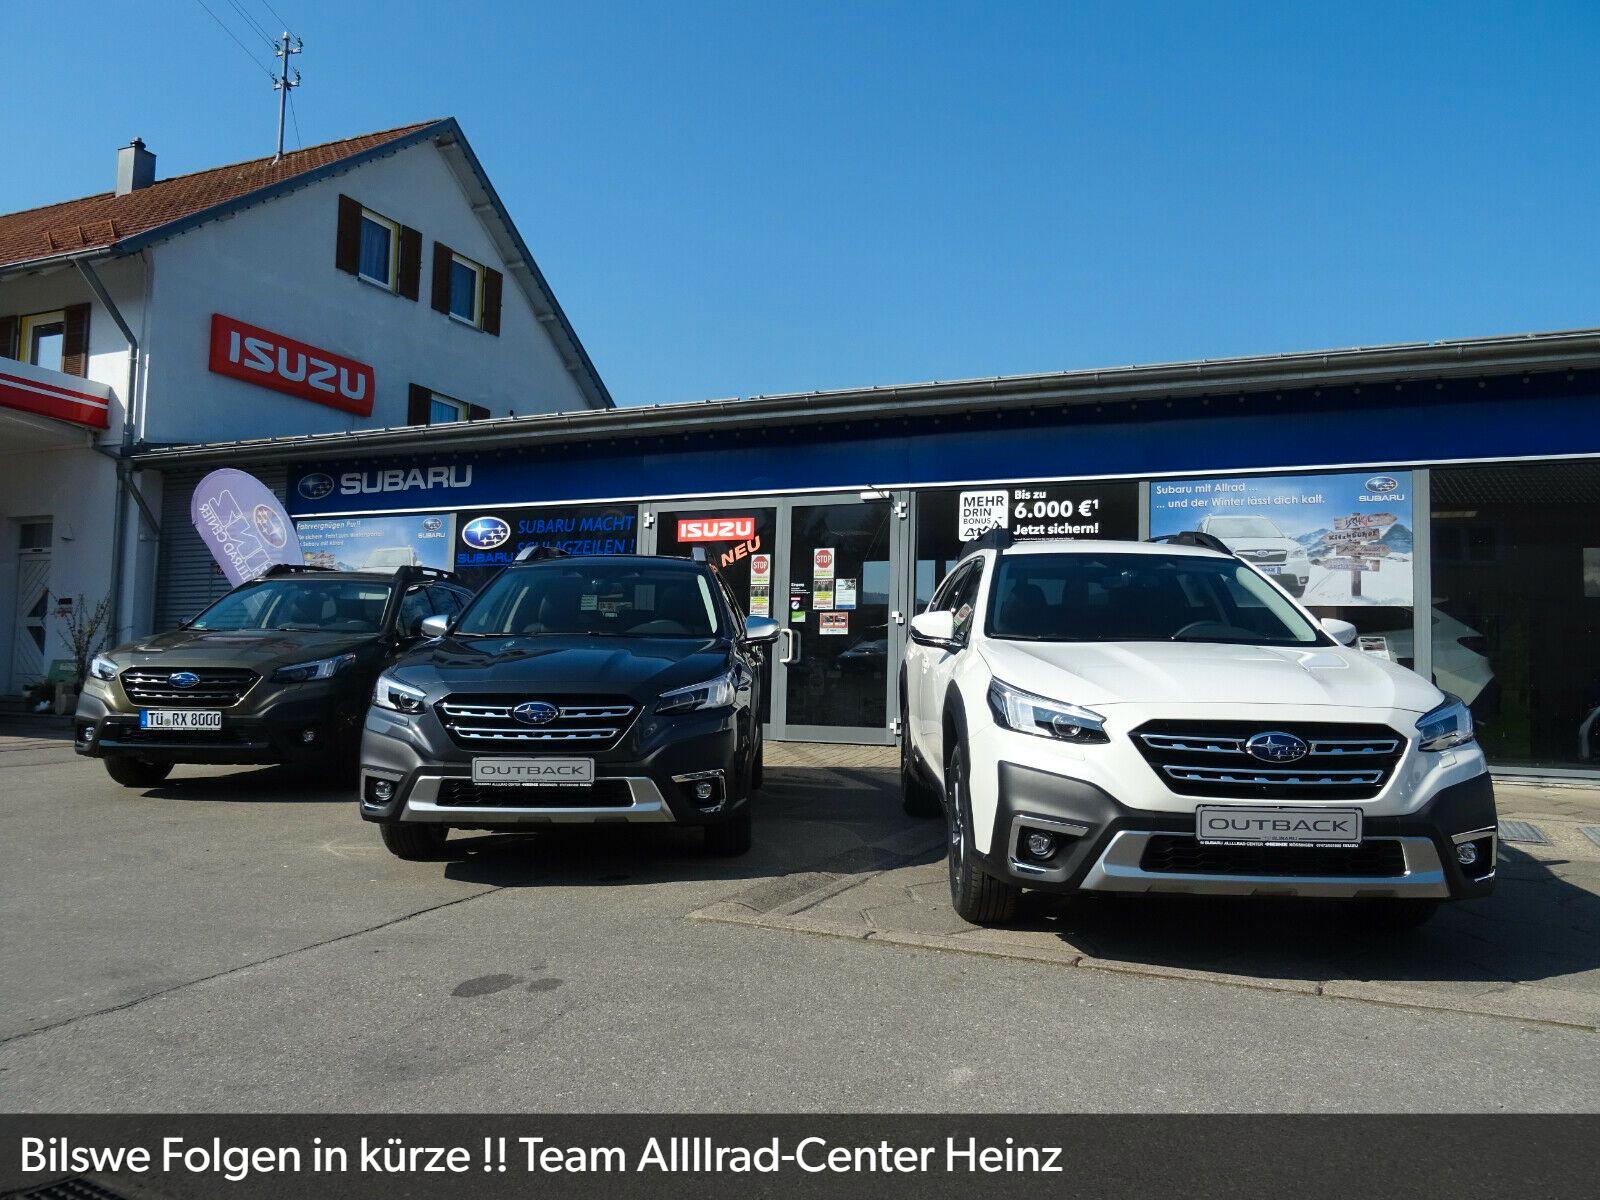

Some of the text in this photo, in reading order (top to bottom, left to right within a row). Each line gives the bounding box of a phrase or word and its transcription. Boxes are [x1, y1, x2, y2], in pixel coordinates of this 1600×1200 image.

[229, 331, 365, 400] ISUZU
[340, 465, 472, 495] SUBARU
[1014, 490, 1046, 500] Bis zu
[1156, 485, 1192, 495] Subaru
[1195, 484, 1211, 493] mit
[1215, 483, 1246, 492] Allrad
[963, 496, 1004, 507] MEHR
[1168, 499, 1188, 508] und
[1191, 499, 1208, 507] der
[1212, 497, 1244, 506] Winter
[1274, 495, 1298, 505] dich
[1301, 494, 1325, 504] kalt.
[1358, 494, 1405, 502] SUBARU
[963, 508, 992, 517] DRIN
[1014, 501, 1073, 519] 6.000
[518, 515, 634, 534] SUBARU MACHT
[680, 521, 752, 537] ISUZU
[1013, 523, 1099, 536] Jetzt sichern!
[417, 531, 446, 539] SUBARU
[721, 535, 761, 567] NEU
[457, 552, 513, 563] SUBARU
[817, 555, 832, 563] STOP
[753, 561, 768, 569] STOP
[149, 712, 220, 726] TÜ RX 8000
[481, 765, 583, 775] OUTBACK
[1208, 818, 1349, 832] OUTBACK
